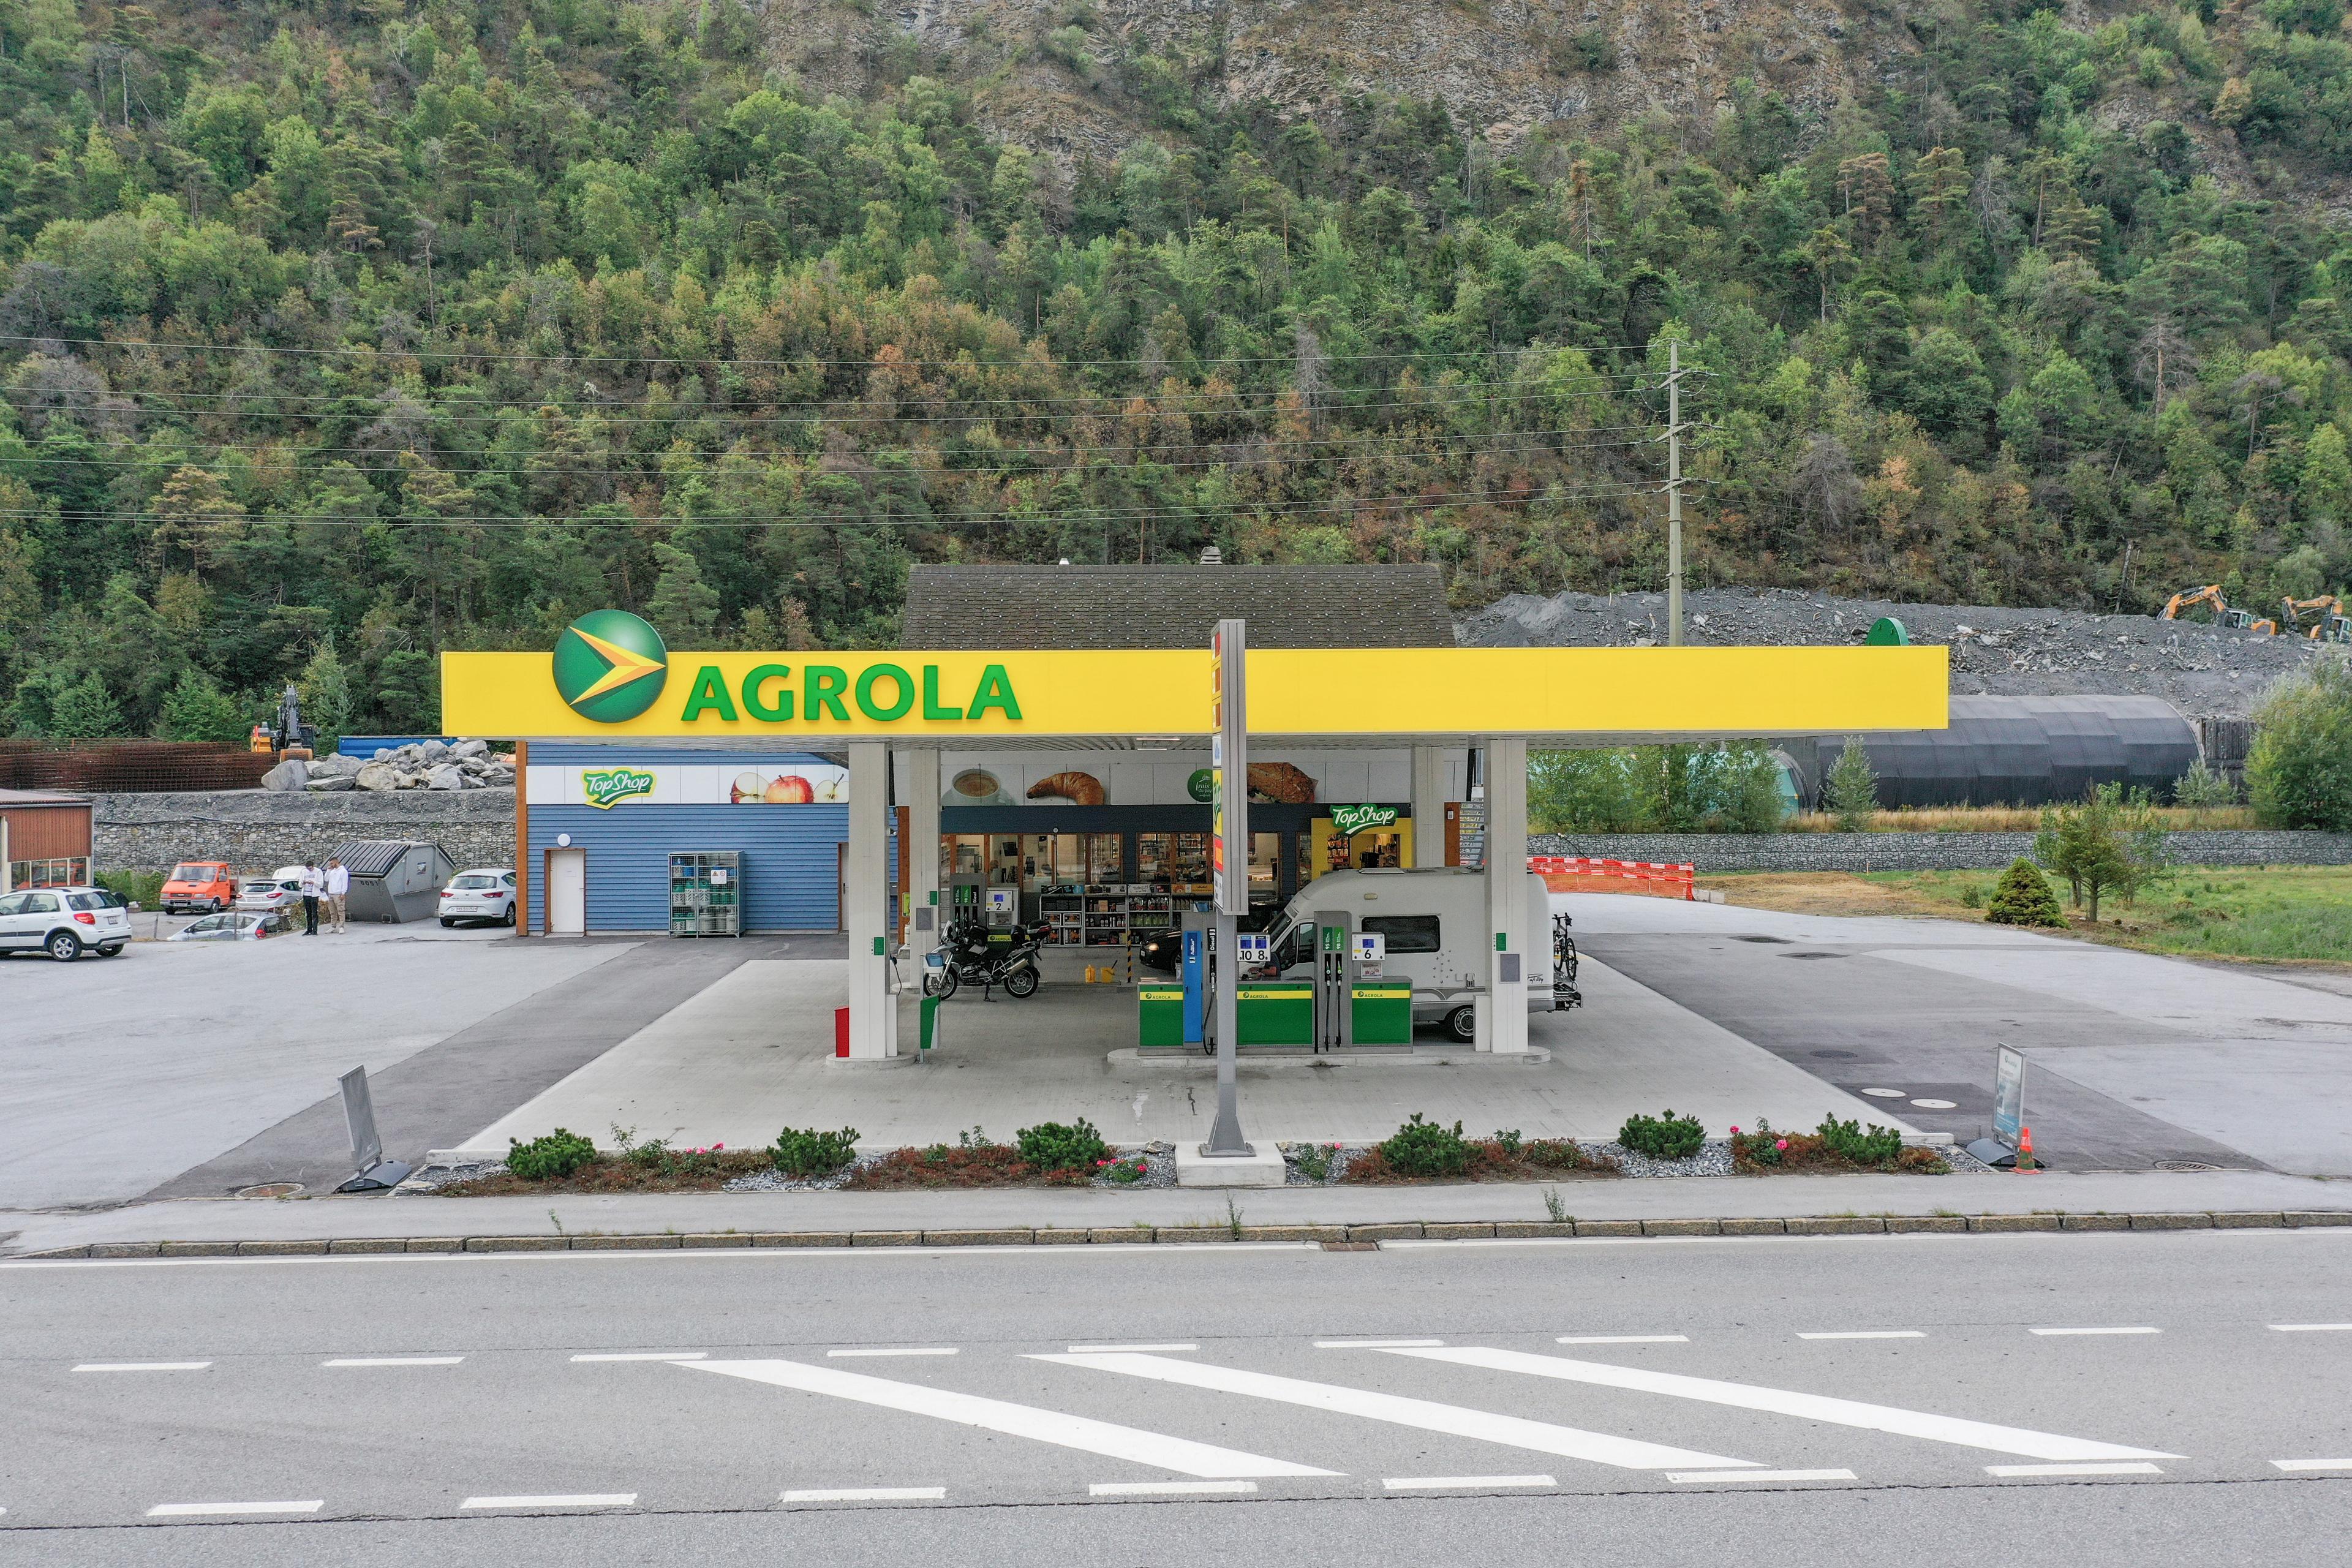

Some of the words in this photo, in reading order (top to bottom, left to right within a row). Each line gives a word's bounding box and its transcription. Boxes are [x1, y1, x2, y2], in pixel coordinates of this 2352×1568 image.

[680, 663, 1023, 723] AGROLA
[995, 902, 1001, 911] 2
[1240, 950, 1252, 960] 10
[1258, 950, 1265, 960] 8
[1365, 949, 1371, 959] 6
